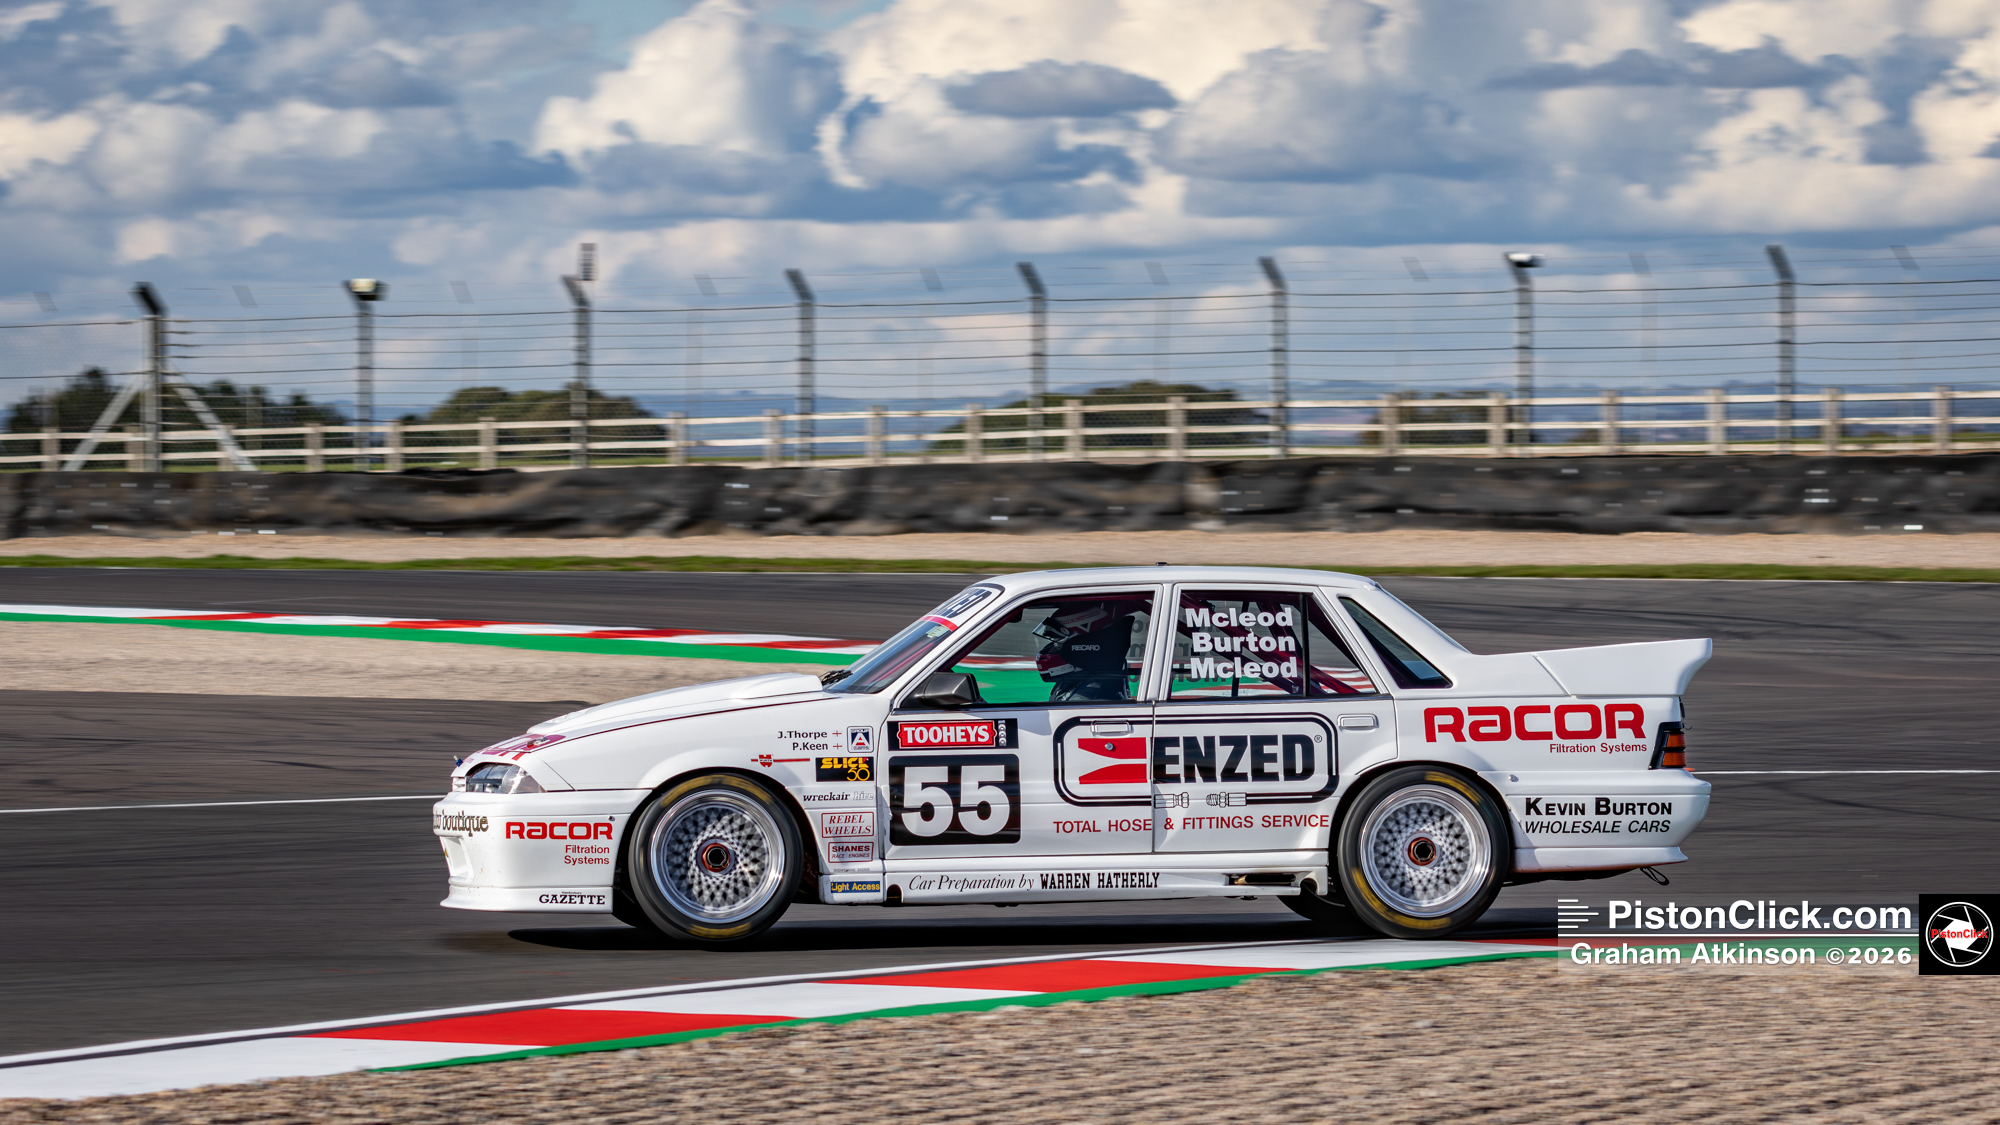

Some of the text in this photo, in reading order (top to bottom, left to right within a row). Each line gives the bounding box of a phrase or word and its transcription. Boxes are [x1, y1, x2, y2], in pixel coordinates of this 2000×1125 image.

[1185, 607, 1293, 628] Mcleod
[1071, 644, 1101, 652] RECARO
[1192, 632, 1296, 653] Burton
[1190, 656, 1298, 679] Mcleod
[777, 731, 828, 740] J.Thorpe
[903, 725, 990, 743] TOOHEYS
[792, 742, 829, 751] P.Keen
[1549, 742, 1647, 755] Filtration Systems
[820, 757, 869, 769] SLICK
[1152, 734, 1315, 784] ENZED
[846, 768, 871, 781] 50
[803, 791, 874, 801] wreckair hire
[901, 765, 1010, 836] 55
[829, 815, 865, 825] REBEL
[1053, 814, 1330, 834] TOTAL HOSE & FITTINGS SERVICE
[824, 825, 872, 835] WHEELS
[1524, 820, 1670, 834] WHOLESALE CARS
[565, 844, 610, 854] Filtration
[831, 845, 870, 853] SHANES
[563, 855, 610, 865] Systems
[831, 882, 880, 893] Light Access
[909, 872, 1160, 892] Car Preparation by WARREN HATHERLY
[538, 894, 606, 905] GAZETTE
